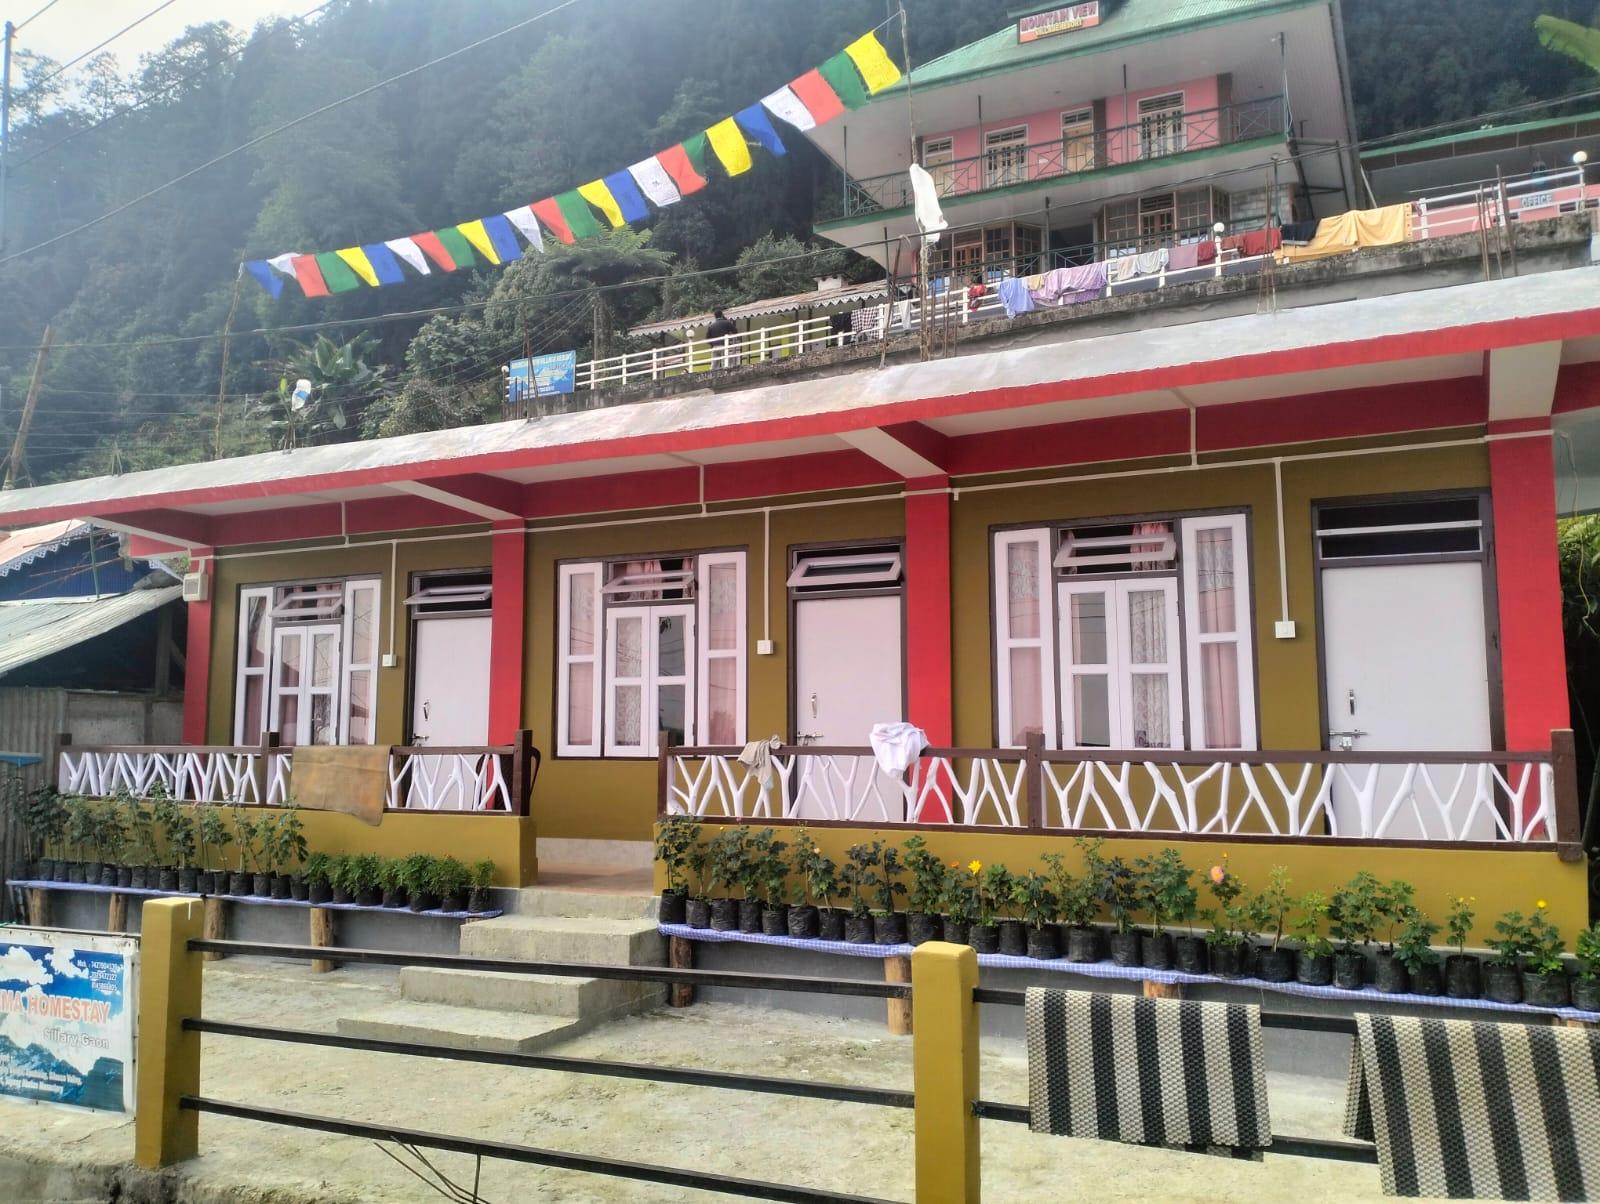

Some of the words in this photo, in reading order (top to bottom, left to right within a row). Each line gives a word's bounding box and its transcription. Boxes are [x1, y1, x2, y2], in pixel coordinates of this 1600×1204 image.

[1020, 8, 1069, 32] MOUNTAIN
[1072, 3, 1097, 19] VIEW
[1521, 194, 1552, 208] OFFICE
[28, 994, 111, 1024] HOMESTAY
[81, 1033, 110, 1049] Gaon
